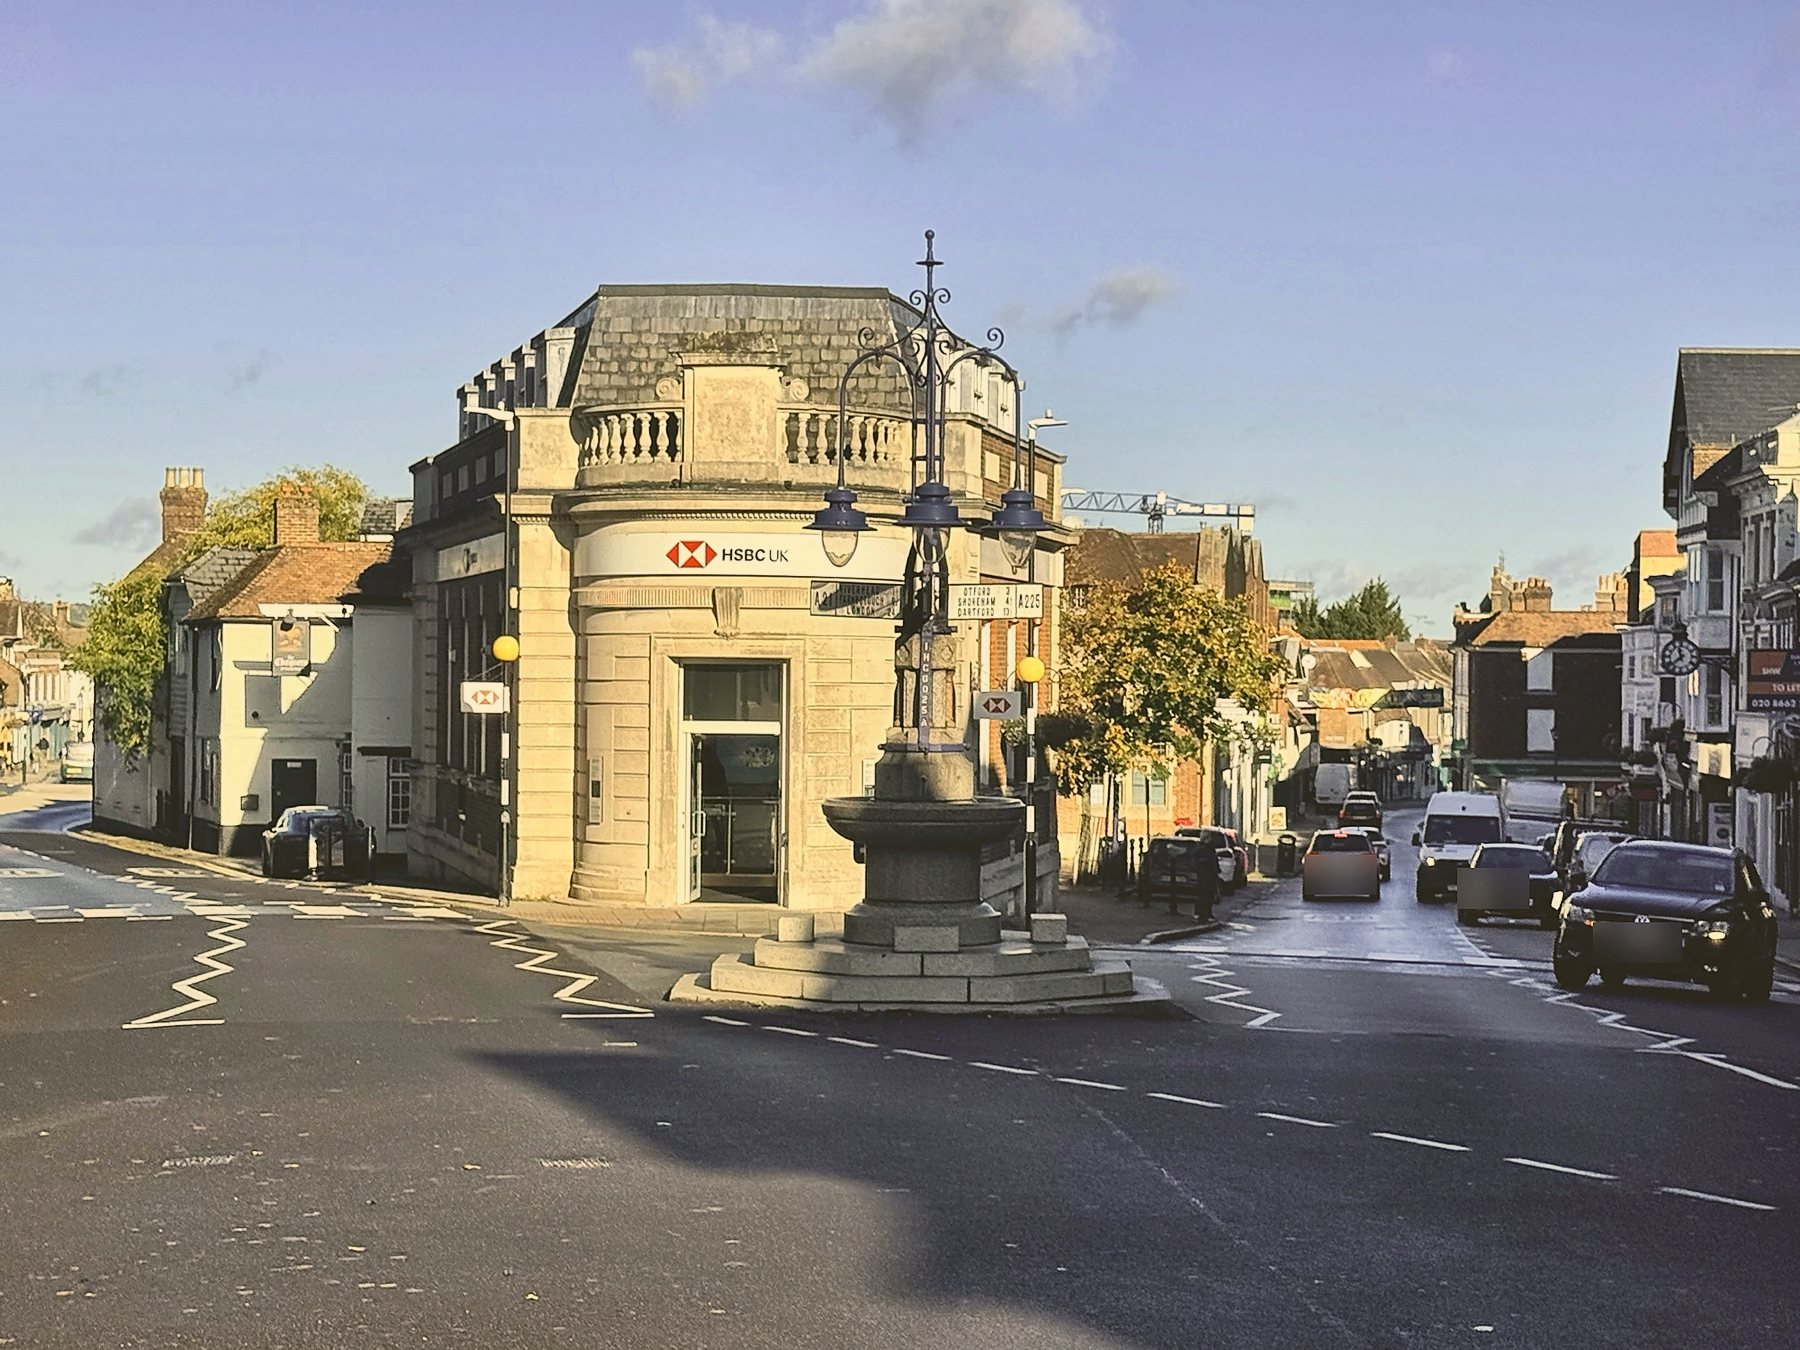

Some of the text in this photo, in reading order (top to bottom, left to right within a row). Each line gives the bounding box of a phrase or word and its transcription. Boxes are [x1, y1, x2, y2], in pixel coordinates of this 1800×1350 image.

[722, 548, 789, 562] HSBC UK
[963, 587, 991, 596] OTFORD
[958, 597, 996, 607] SHOREHAM
[1018, 593, 1041, 609] A225
[846, 605, 875, 616] LONDON
[958, 607, 995, 617] DARTFORD
[1772, 683, 1785, 692] TO
[1751, 699, 1770, 708] 020
